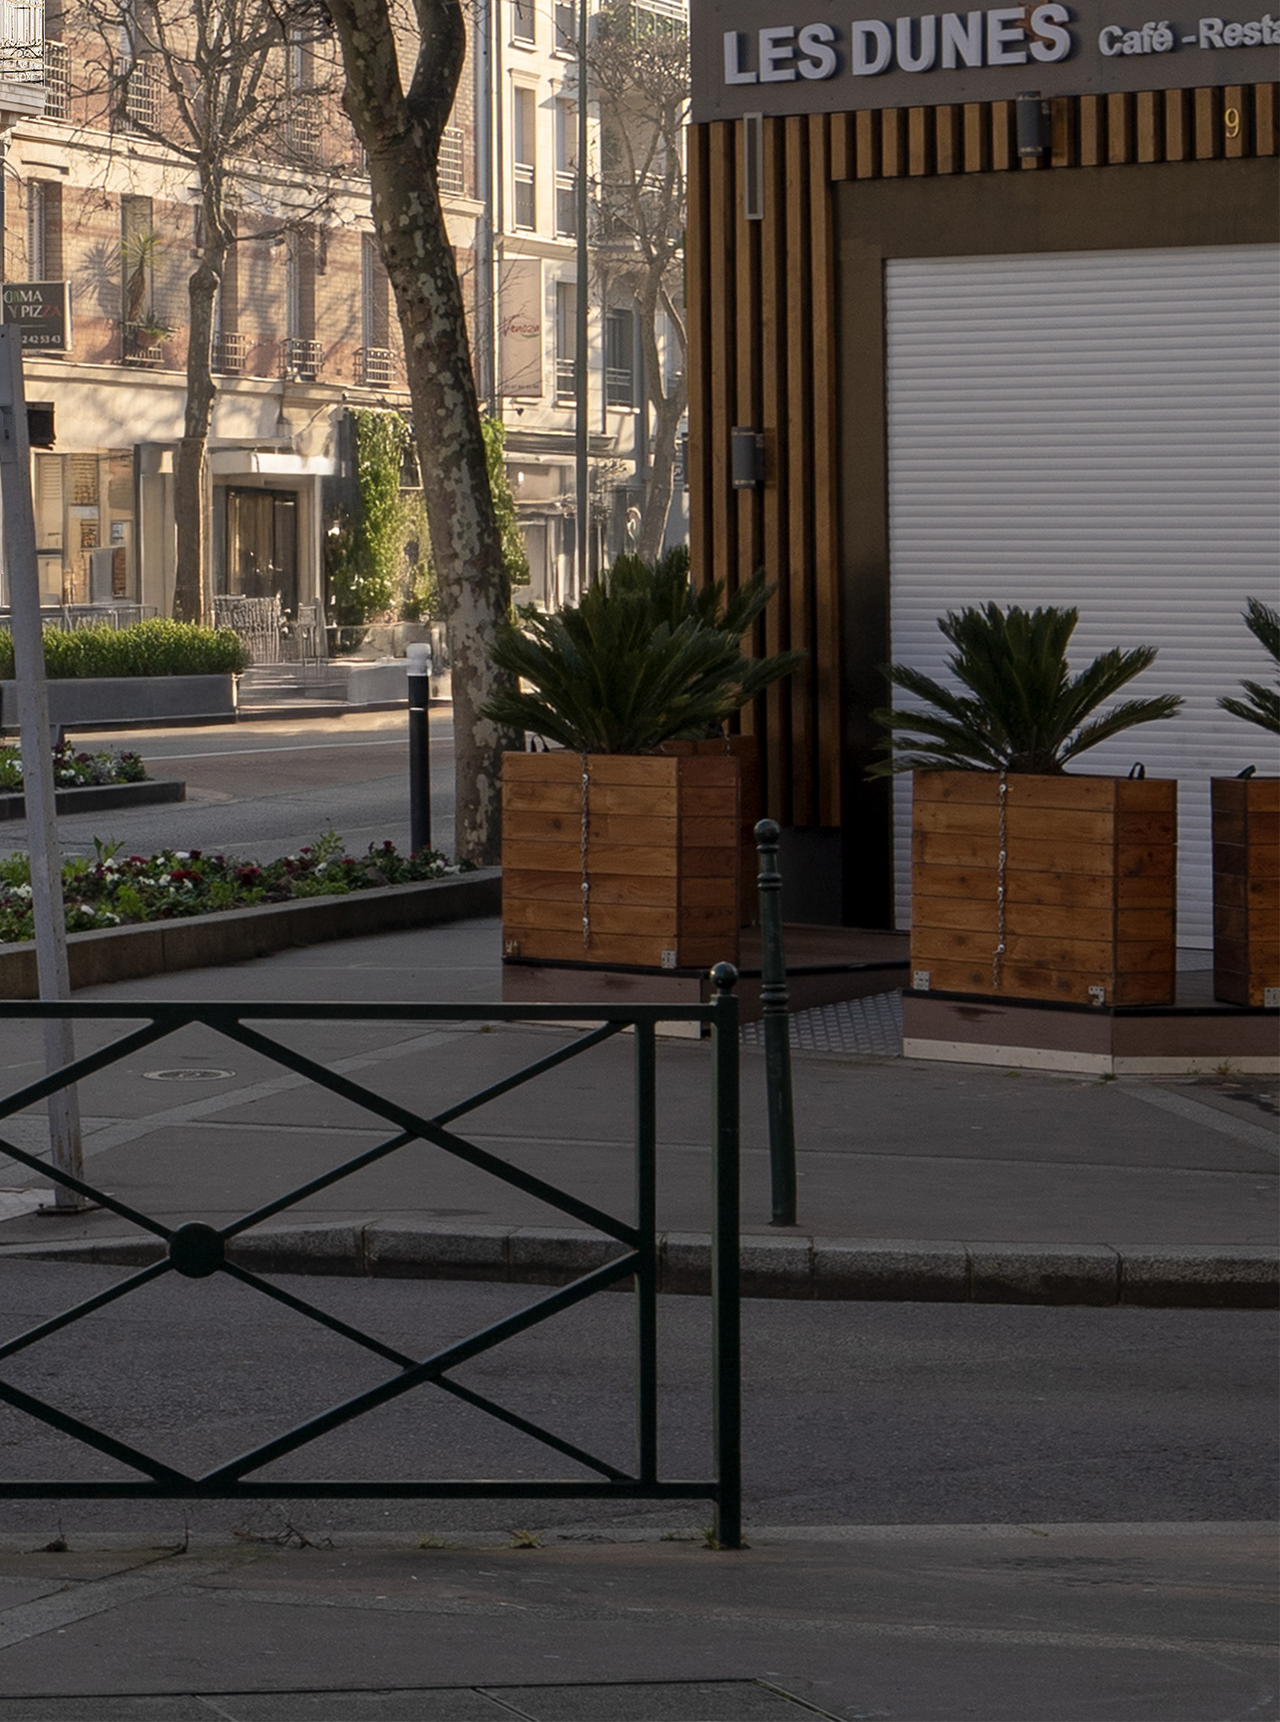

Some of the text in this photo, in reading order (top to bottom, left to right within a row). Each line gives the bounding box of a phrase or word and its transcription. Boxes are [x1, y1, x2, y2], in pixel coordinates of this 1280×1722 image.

[724, 3, 1072, 85] LES DUNES
[1099, 20, 1174, 56] Café
[1224, 108, 1240, 138] 9
[21, 305, 61, 317] PIZZA
